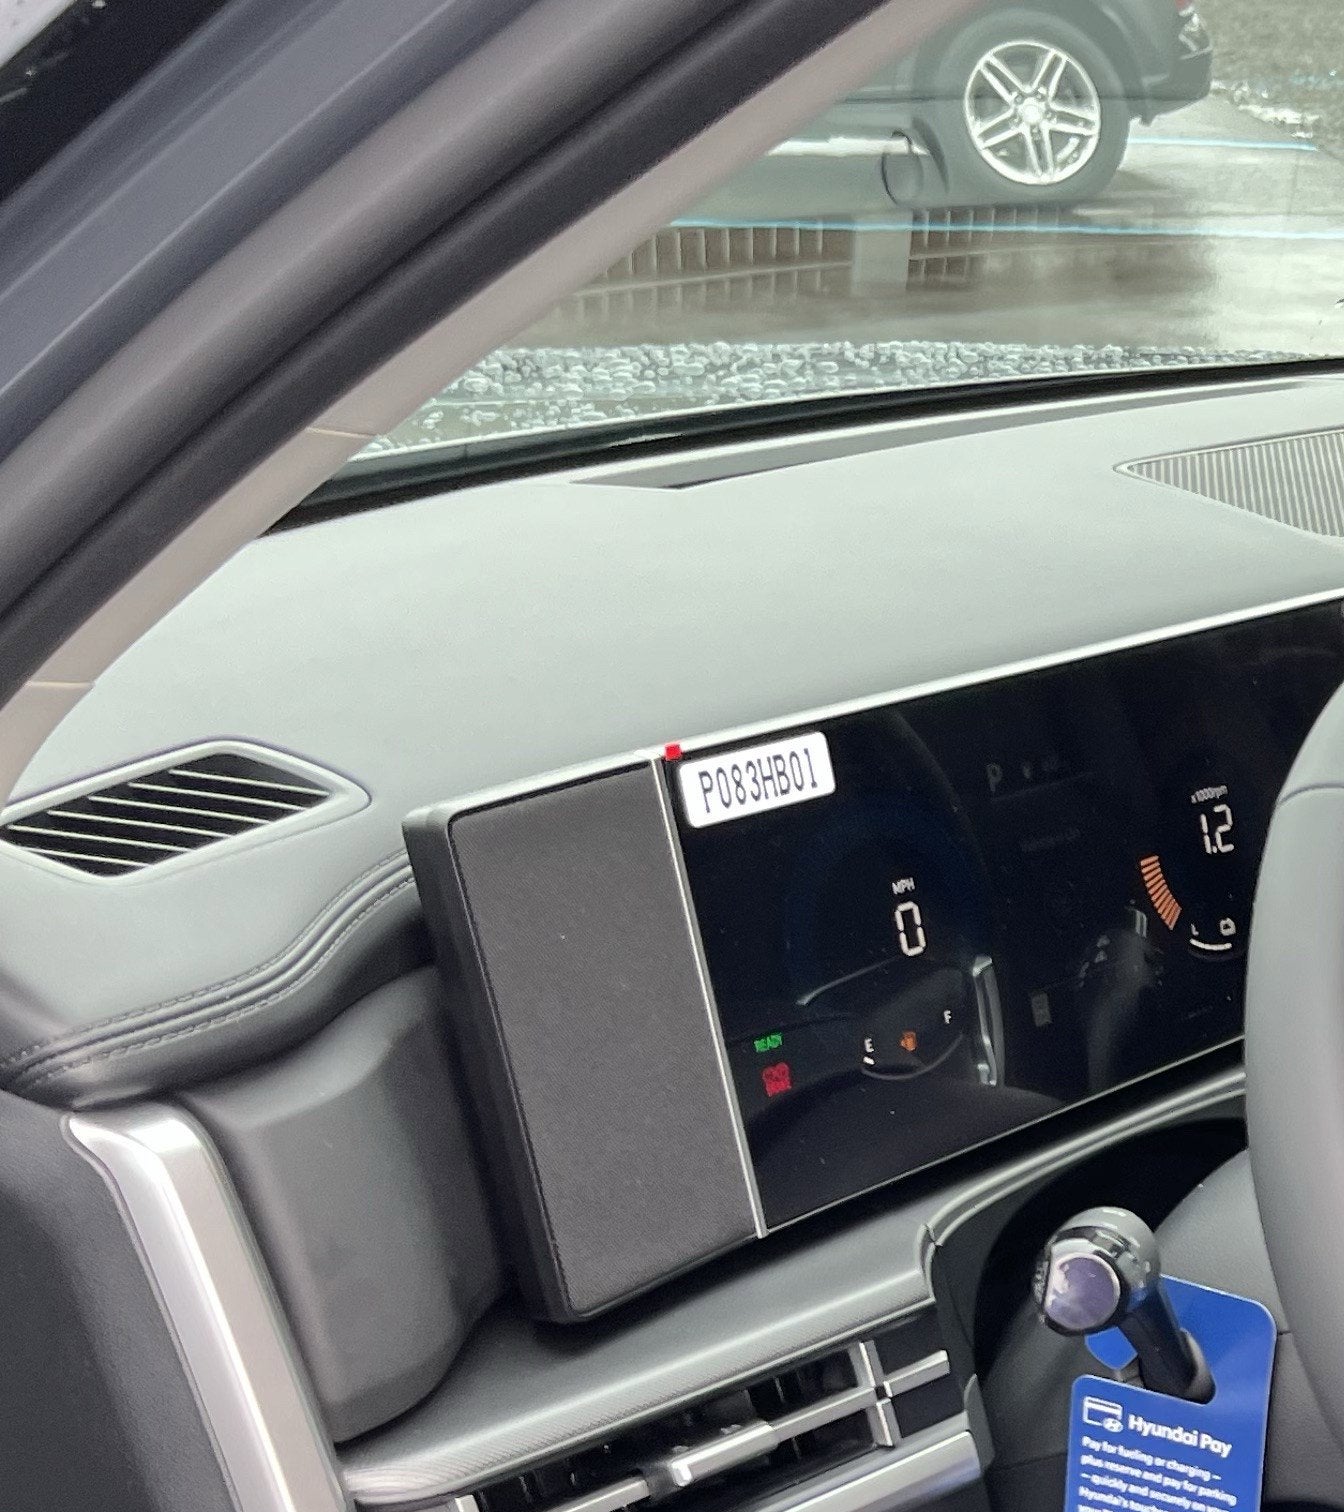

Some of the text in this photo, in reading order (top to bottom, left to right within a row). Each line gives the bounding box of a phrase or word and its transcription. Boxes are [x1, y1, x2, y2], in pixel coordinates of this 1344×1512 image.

[698, 747, 820, 814] P083HB01
[1200, 803, 1235, 855] 1.2
[891, 877, 916, 895] MPH
[894, 900, 927, 957] 0
[864, 1036, 875, 1053] E
[1128, 1414, 1233, 1458] Hyundai Pay
[1082, 1435, 1101, 1451] Pay
[1101, 1441, 1117, 1454] for
[1166, 1460, 1212, 1482] charging
[1128, 1484, 1149, 1497] and
[1142, 1470, 1163, 1484] and
[1163, 1476, 1182, 1490] pay
[1182, 1479, 1198, 1493] for
[1198, 1486, 1238, 1507] parking
